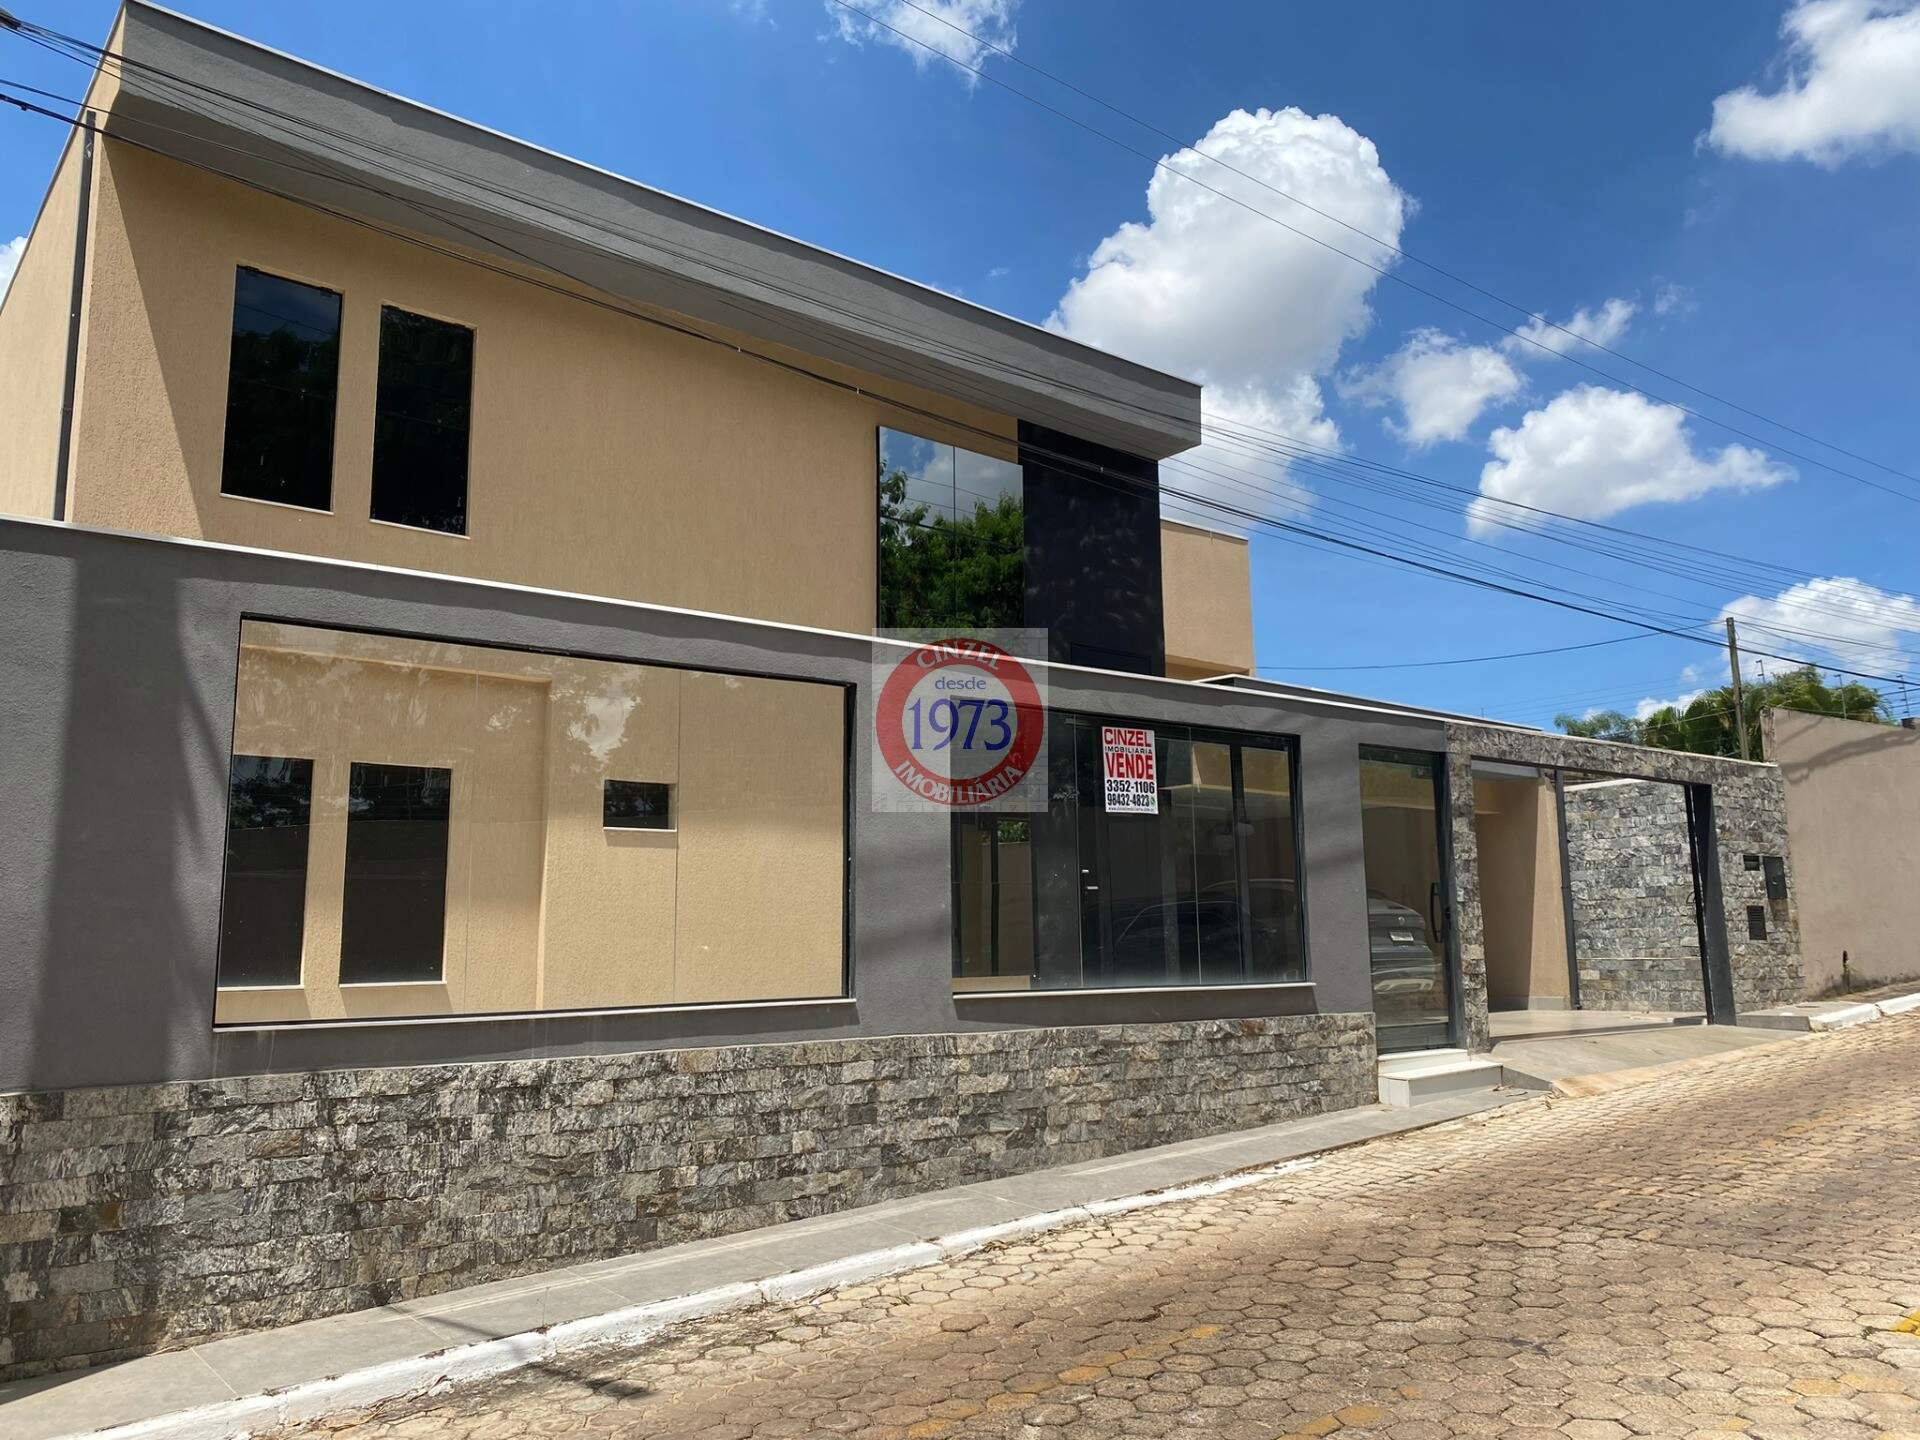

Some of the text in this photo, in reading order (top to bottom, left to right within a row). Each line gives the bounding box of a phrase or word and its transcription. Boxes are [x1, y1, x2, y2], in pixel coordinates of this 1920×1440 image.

[1104, 729, 1152, 747] CINZEL
[1105, 752, 1154, 780] VENDE
[1106, 780, 1155, 794] 3352-1106
